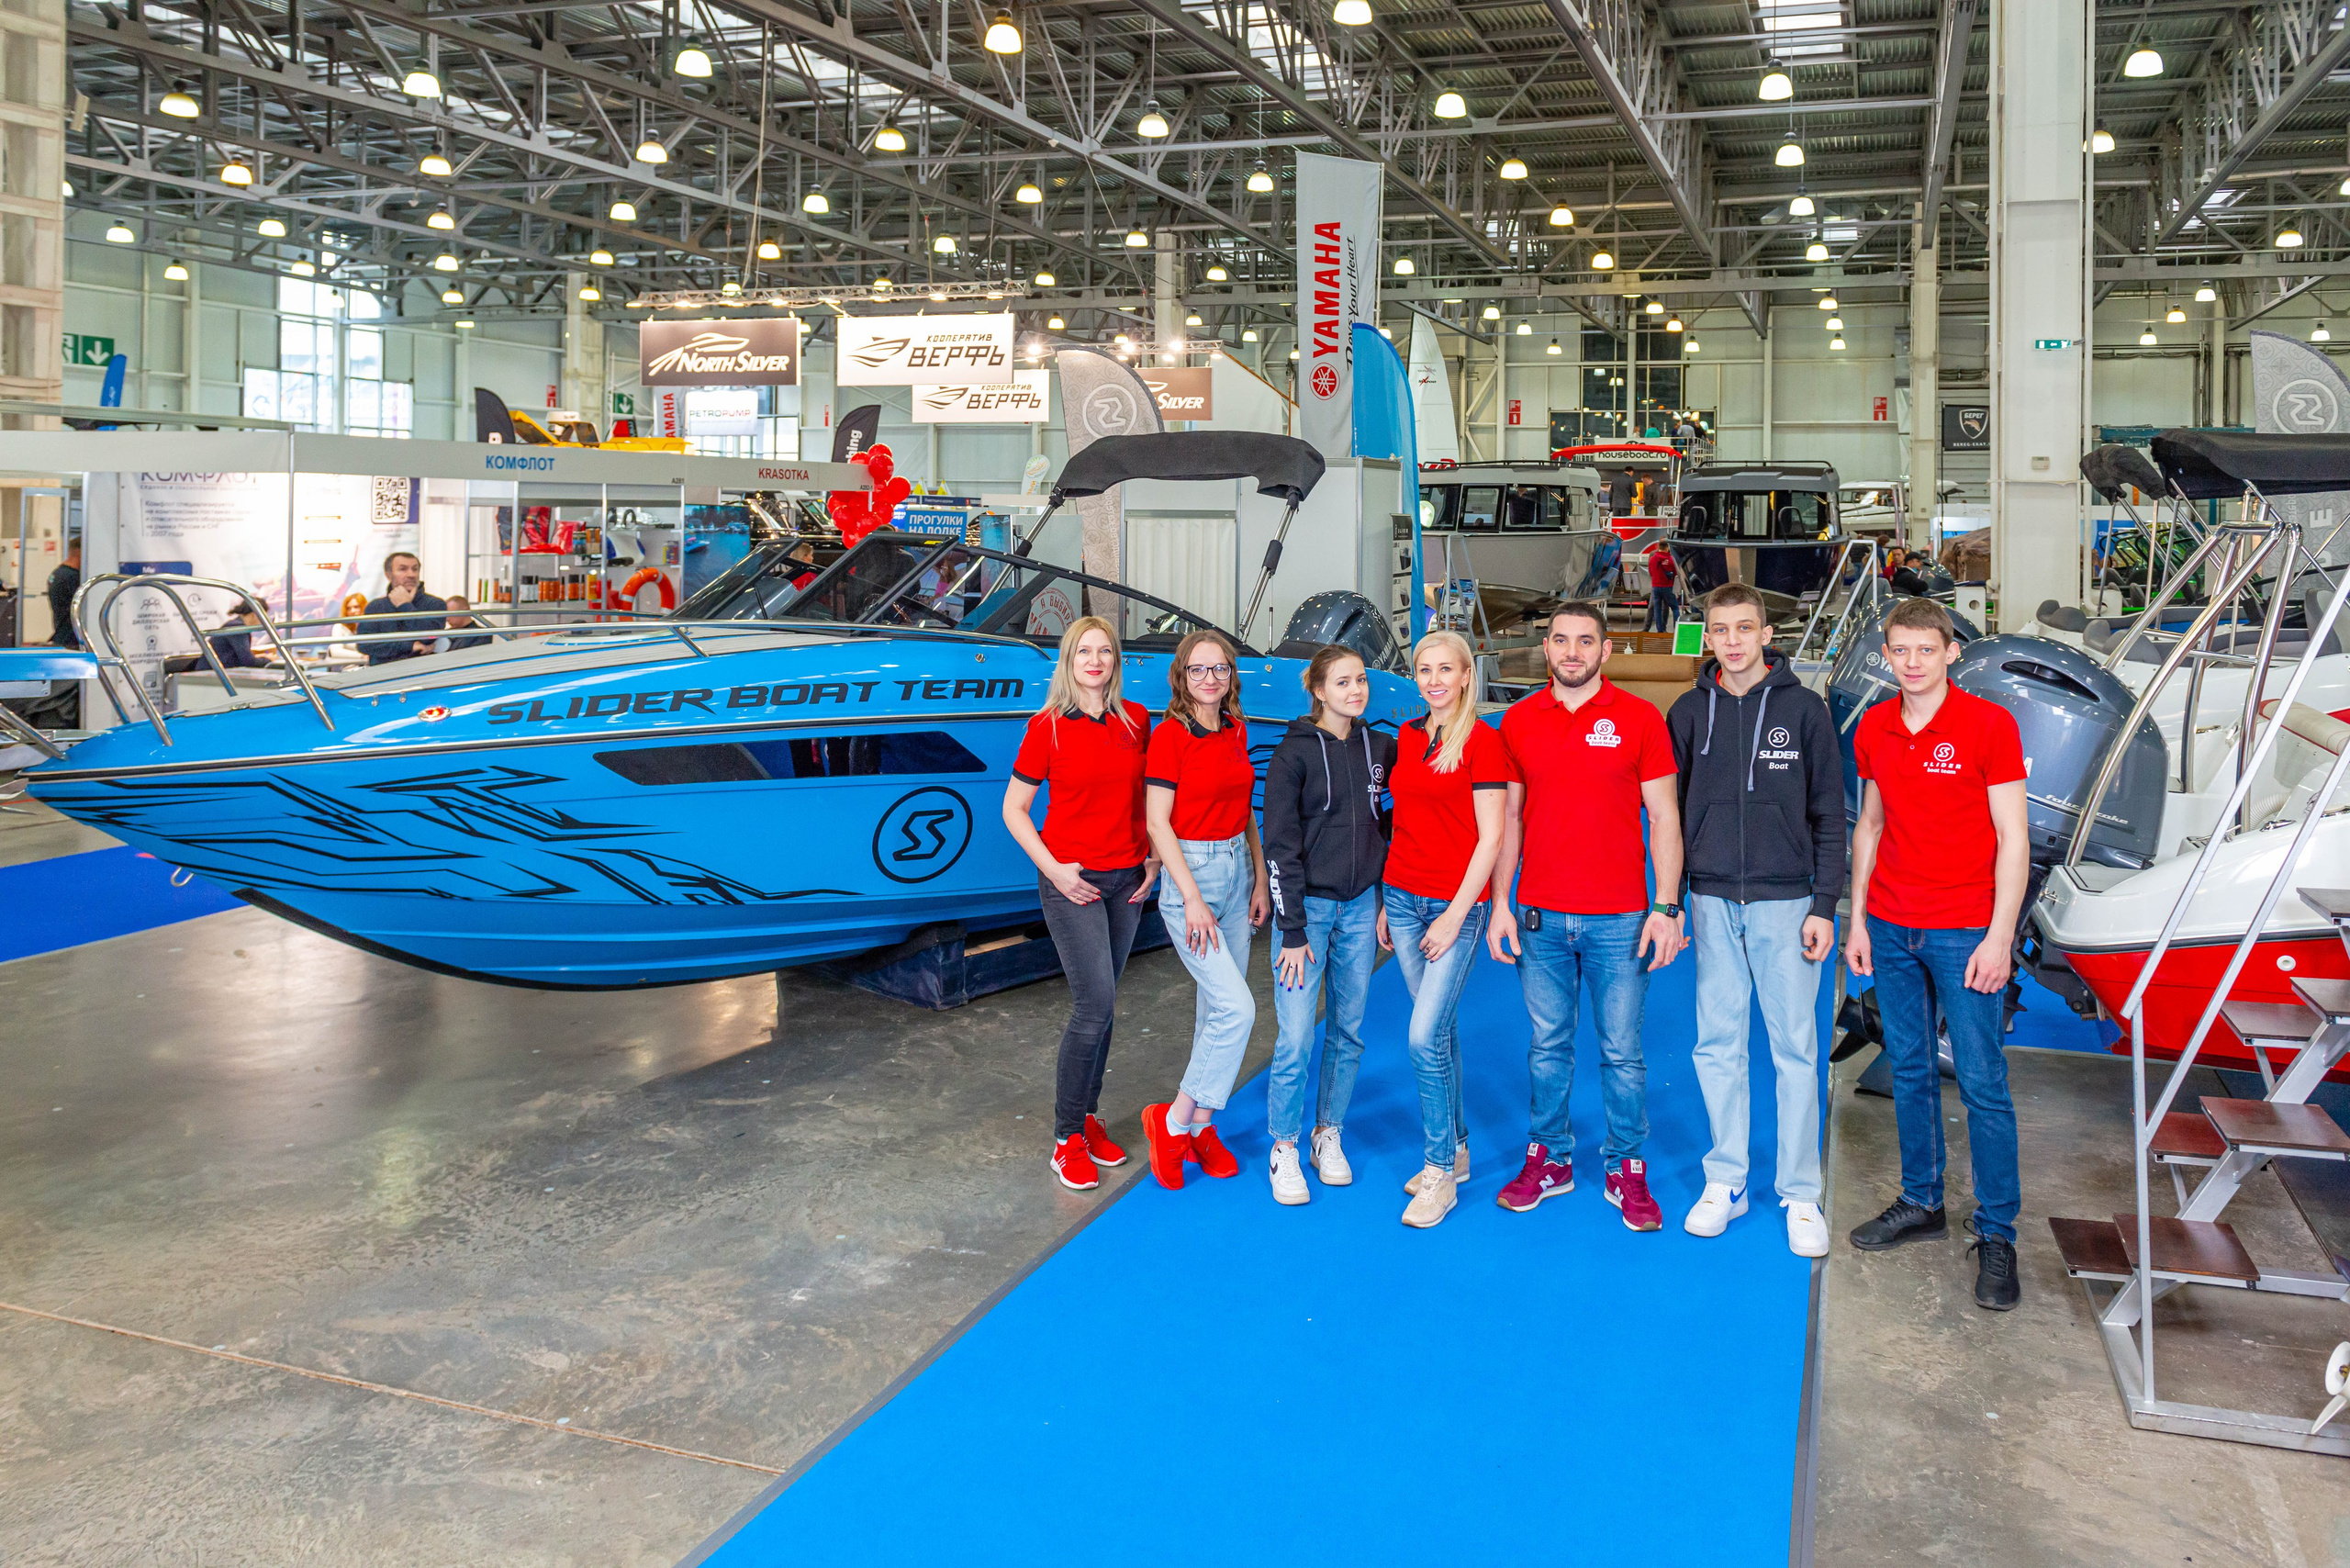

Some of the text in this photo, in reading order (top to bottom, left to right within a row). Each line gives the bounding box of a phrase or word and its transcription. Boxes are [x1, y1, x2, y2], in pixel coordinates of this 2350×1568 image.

[1347, 235, 1358, 278] Heart
[1313, 221, 1340, 358] YAMAHA
[926, 333, 992, 342] КООПЕРАТИВ
[676, 351, 789, 373] NORTH SILVER
[907, 345, 1005, 367] ВЕРФЬ
[967, 393, 1042, 409] ВЕРФЬ
[1157, 393, 1204, 410] SILVER
[664, 393, 677, 438] AMAHA
[845, 429, 863, 464] hing
[486, 454, 554, 472] КОМФЛОТ
[758, 467, 810, 481] KRASOTKA
[909, 514, 964, 526] ПРОГУЛКИ
[487, 678, 1024, 725] SLIDER BOAT TEAM
[1391, 703, 1431, 719] SLIDE
[1759, 749, 1799, 760] SLIDER
[1769, 761, 1789, 770] Boat
[1923, 761, 1962, 770] SLIDER
